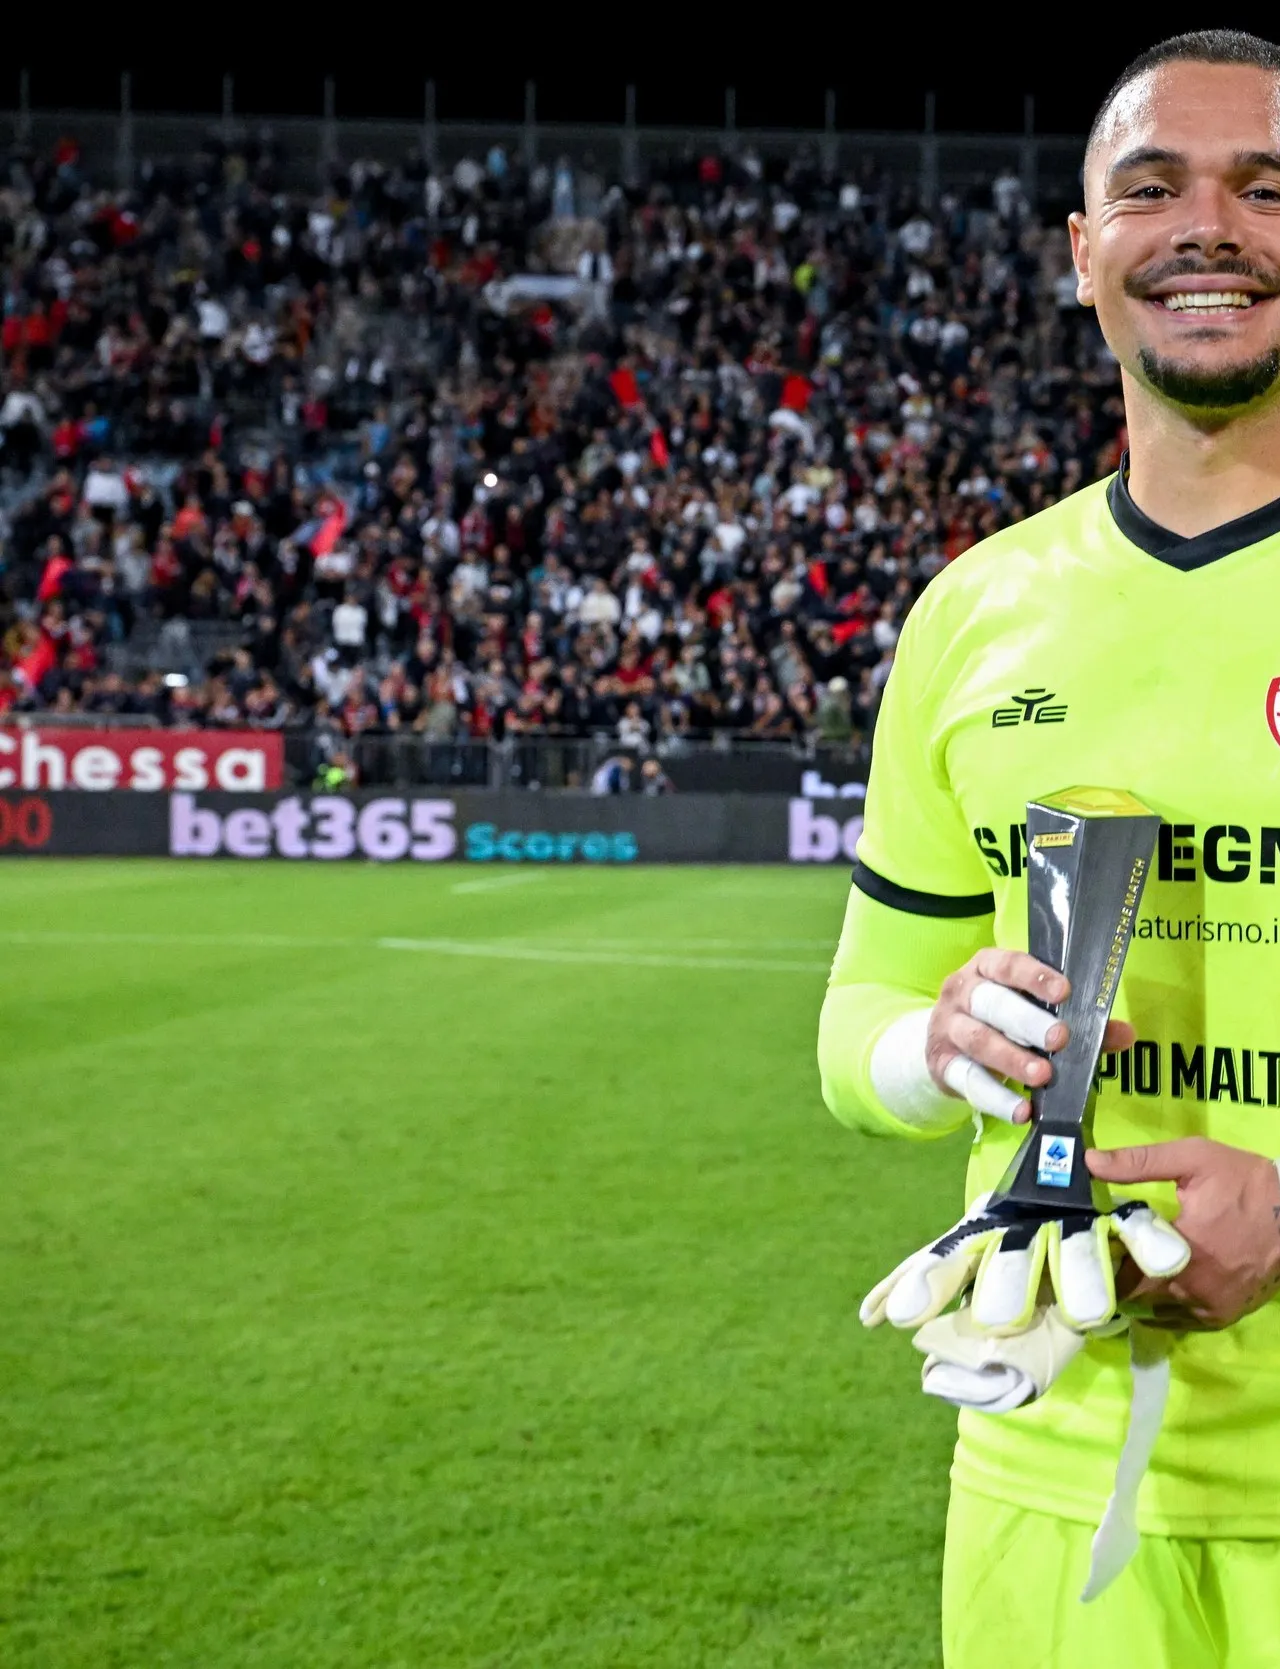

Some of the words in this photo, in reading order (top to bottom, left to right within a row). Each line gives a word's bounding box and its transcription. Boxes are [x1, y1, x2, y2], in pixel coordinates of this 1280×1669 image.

[170, 792, 457, 861] bet365
[465, 822, 639, 861] Scores
[1124, 858, 1145, 907] MATCH
[1116, 906, 1132, 935] THE
[1111, 934, 1125, 954] OF
